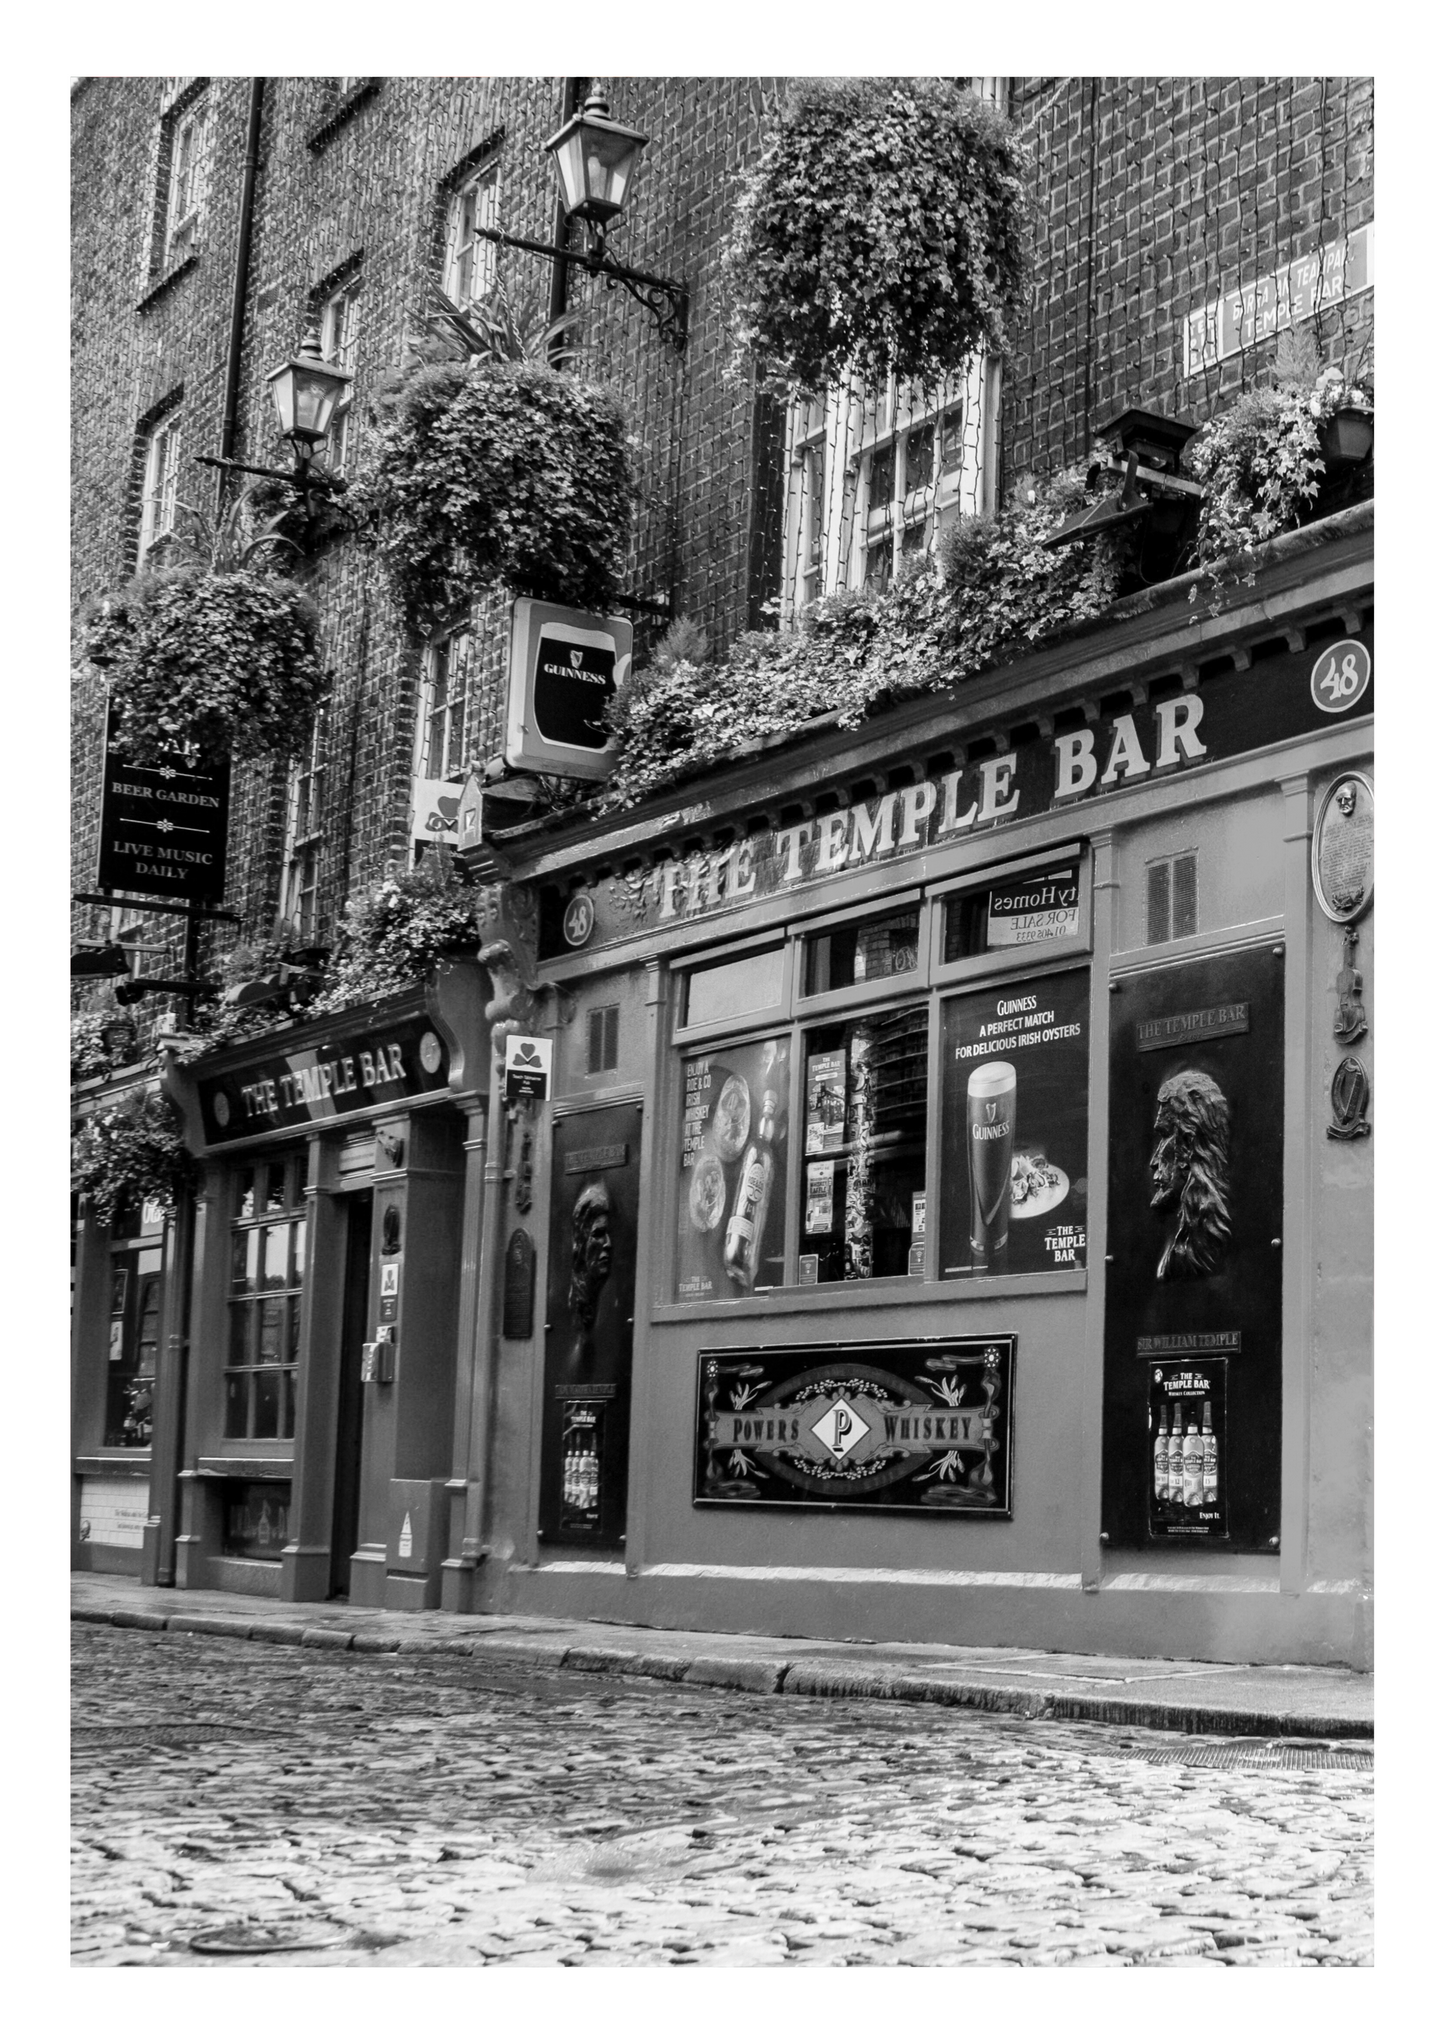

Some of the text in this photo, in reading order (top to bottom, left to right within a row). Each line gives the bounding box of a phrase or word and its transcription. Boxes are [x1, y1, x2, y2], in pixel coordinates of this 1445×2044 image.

[1244, 294, 1304, 338] TEMPLE
[543, 663, 606, 685] GUINNESS
[1320, 653, 1359, 701] 48
[112, 781, 220, 808] BEER GARDEN
[776, 753, 1020, 871] TEMPLE
[1054, 693, 1207, 798] BAR
[113, 841, 213, 866] LIVE MUSIC
[135, 862, 189, 880] DAILY
[568, 904, 588, 939] 48
[979, 1010, 1055, 1037] A PERFECT MATCH
[1139, 1022, 1161, 1039] THE
[1164, 1010, 1216, 1034] TEMPLE
[1218, 1005, 1246, 1025] BAR
[955, 1023, 1081, 1059] FOR DELICIOUS IRISH OYSTERS
[241, 1079, 279, 1117] THE
[279, 1056, 357, 1108] TEMPLE
[359, 1043, 407, 1087] BAR
[1044, 1234, 1086, 1250] TEMPLE
[1057, 1225, 1074, 1236] THE
[1054, 1249, 1076, 1262] BAR
[1153, 1336, 1197, 1349] WILLIAM
[1198, 1332, 1238, 1347] TEMPLE
[1163, 1380, 1210, 1391] TEMPLE BAR
[1180, 1372, 1193, 1380] THE
[732, 1408, 972, 1450] POWERS P WHISKEY
